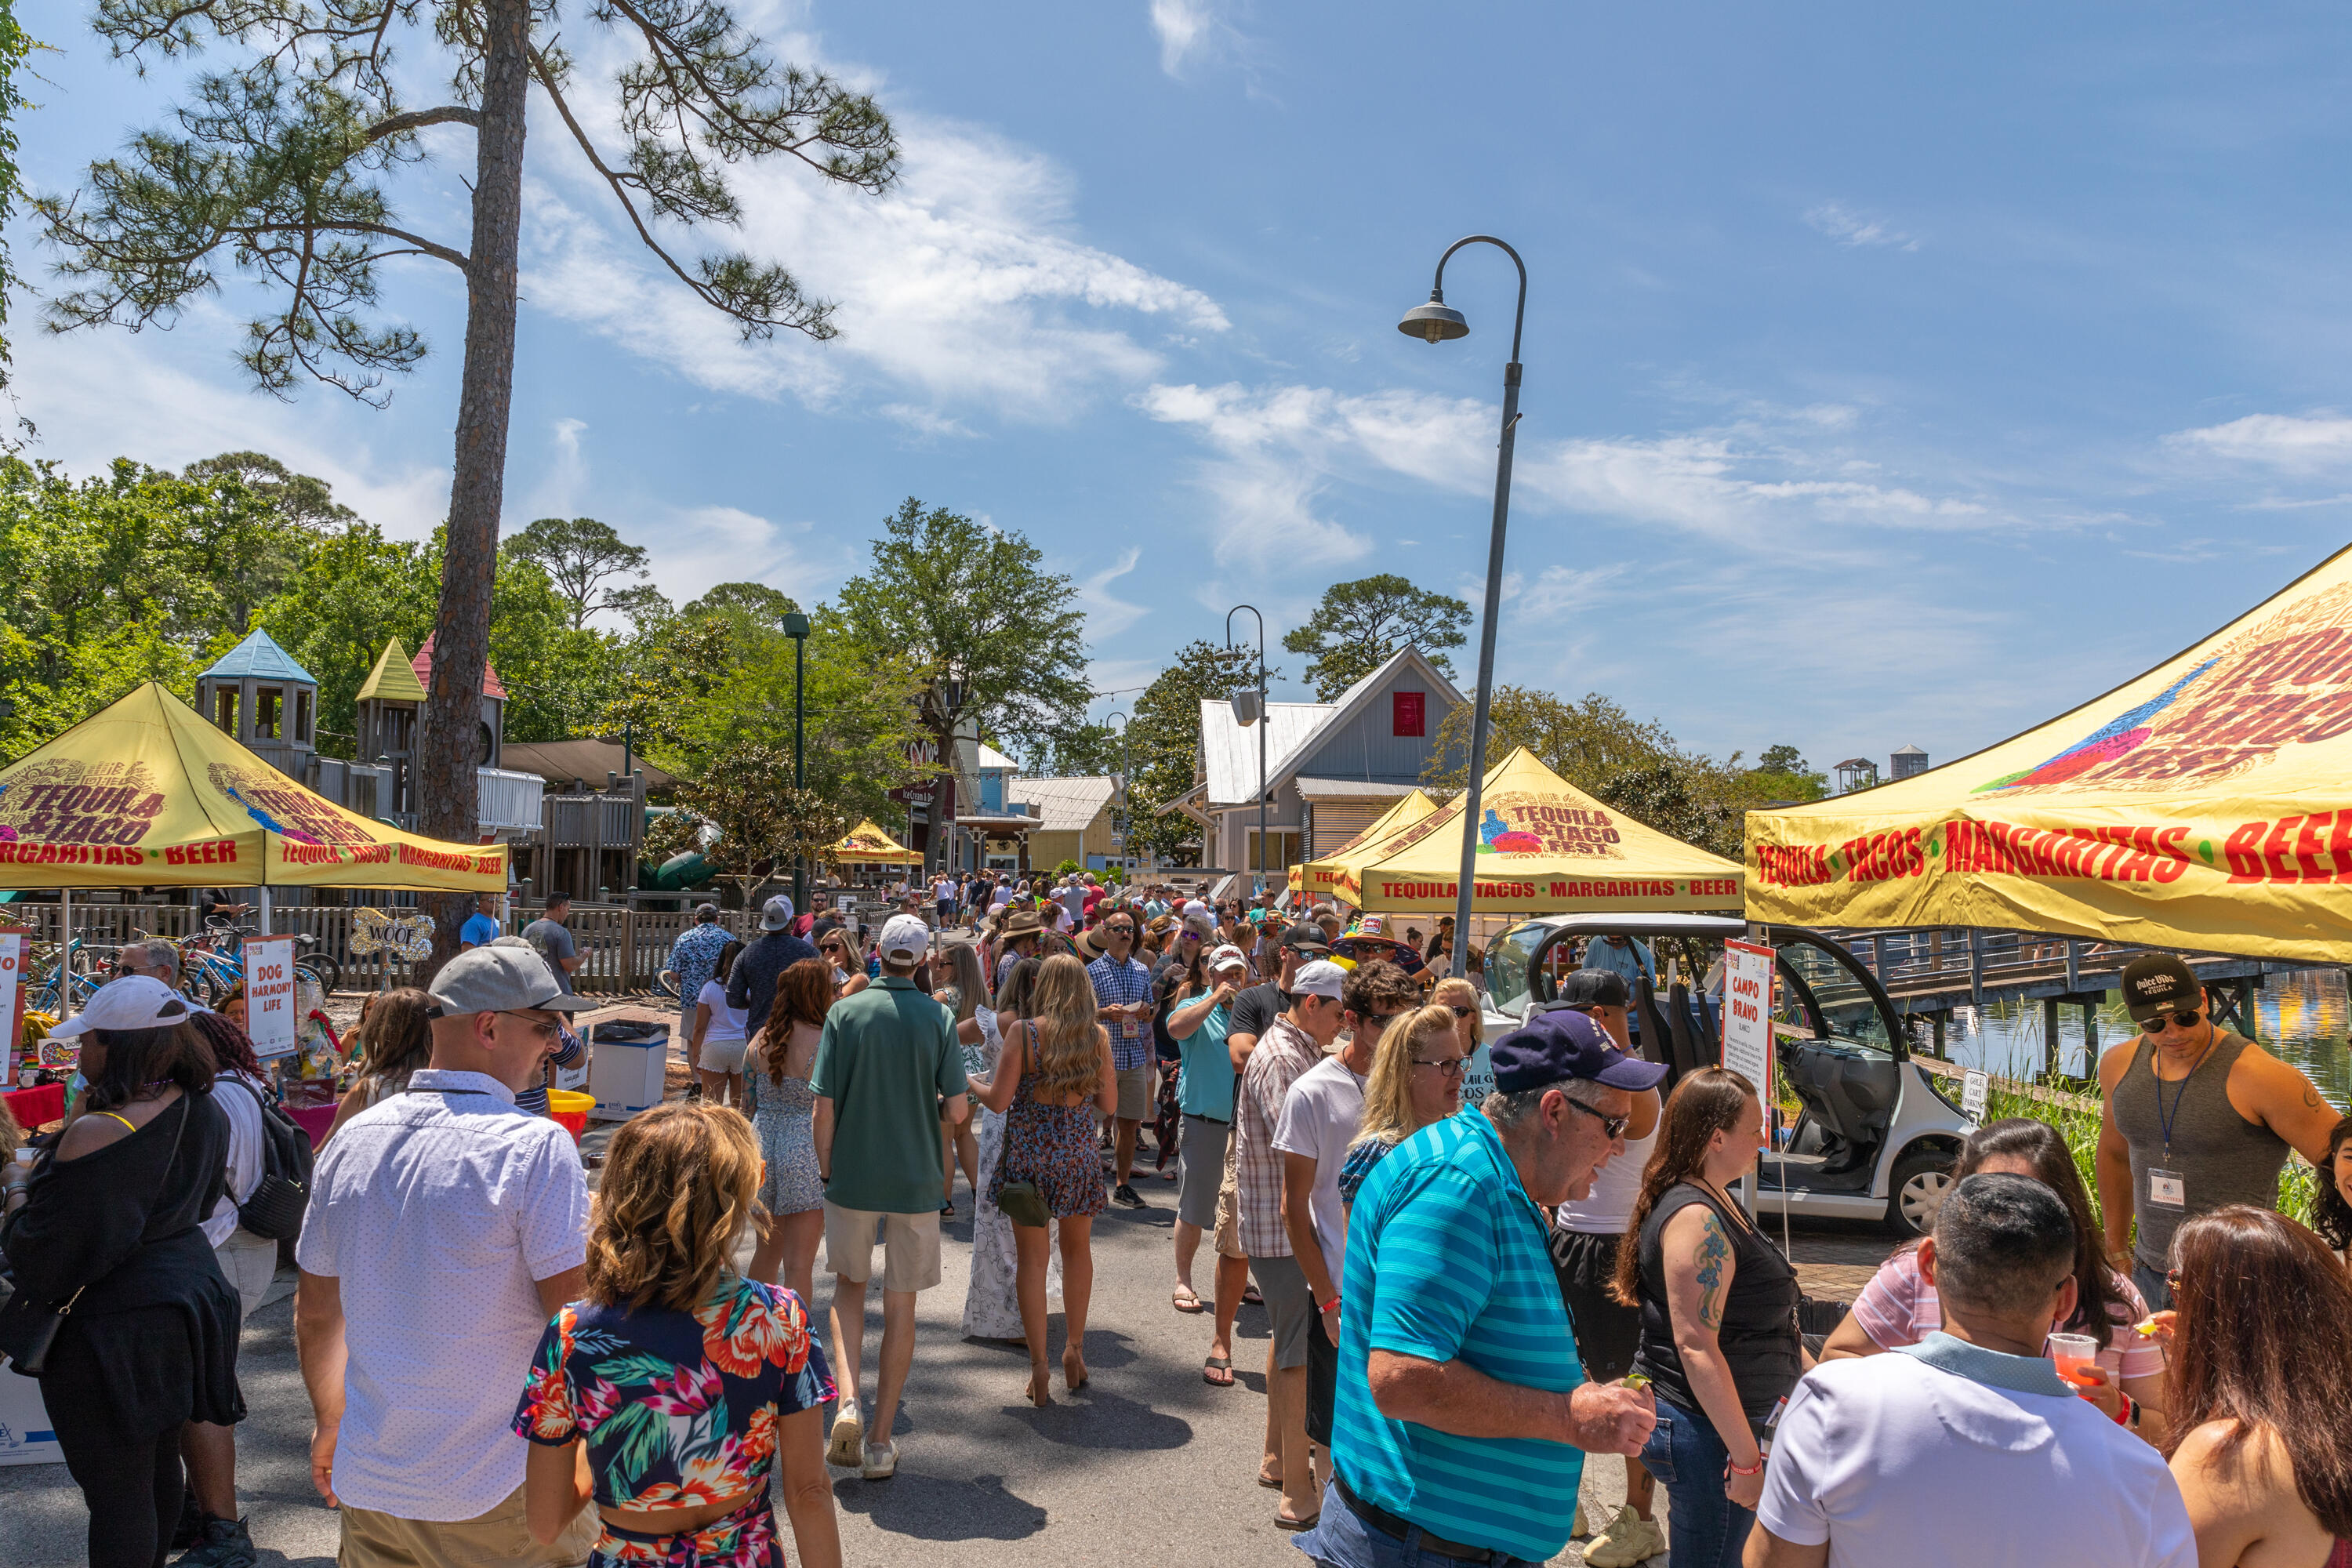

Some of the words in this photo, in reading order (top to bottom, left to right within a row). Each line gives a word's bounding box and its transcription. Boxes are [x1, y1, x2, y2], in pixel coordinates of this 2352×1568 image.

[19, 784, 165, 818] TEQUILA
[247, 789, 343, 818] TEQUILA
[909, 790, 924, 801] Cream
[1512, 806, 1611, 826] TEQUILA
[0, 841, 143, 866] RGARITAS
[165, 840, 237, 866] BEER
[281, 840, 343, 866] TEQUILA
[346, 844, 391, 863] TACOS
[399, 843, 471, 872] MARGARITAS
[476, 856, 502, 875] BEER
[1548, 840, 1608, 855] FEST
[1756, 844, 1831, 889] TEQUILA
[1843, 827, 1924, 882] TACOS
[1945, 820, 2192, 884] MARGARITAS
[1381, 883, 1458, 899] TEQUILA
[1474, 882, 1536, 898] TACOS
[1550, 880, 1675, 898] MARGARITAS
[1690, 879, 1737, 896] BEER
[368, 925, 416, 945] WOOF
[257, 964, 283, 982] DOG
[252, 982, 292, 998] HARMONY
[1733, 976, 1759, 1000] CAMPO
[2136, 978, 2156, 990] Dulce
[2144, 985, 2174, 996] TEQUILA
[263, 998, 281, 1012] LIFE
[1733, 998, 1759, 1023] BRAVO
[1969, 1076, 1983, 1087] GOLF
[1969, 1087, 1981, 1098] CART
